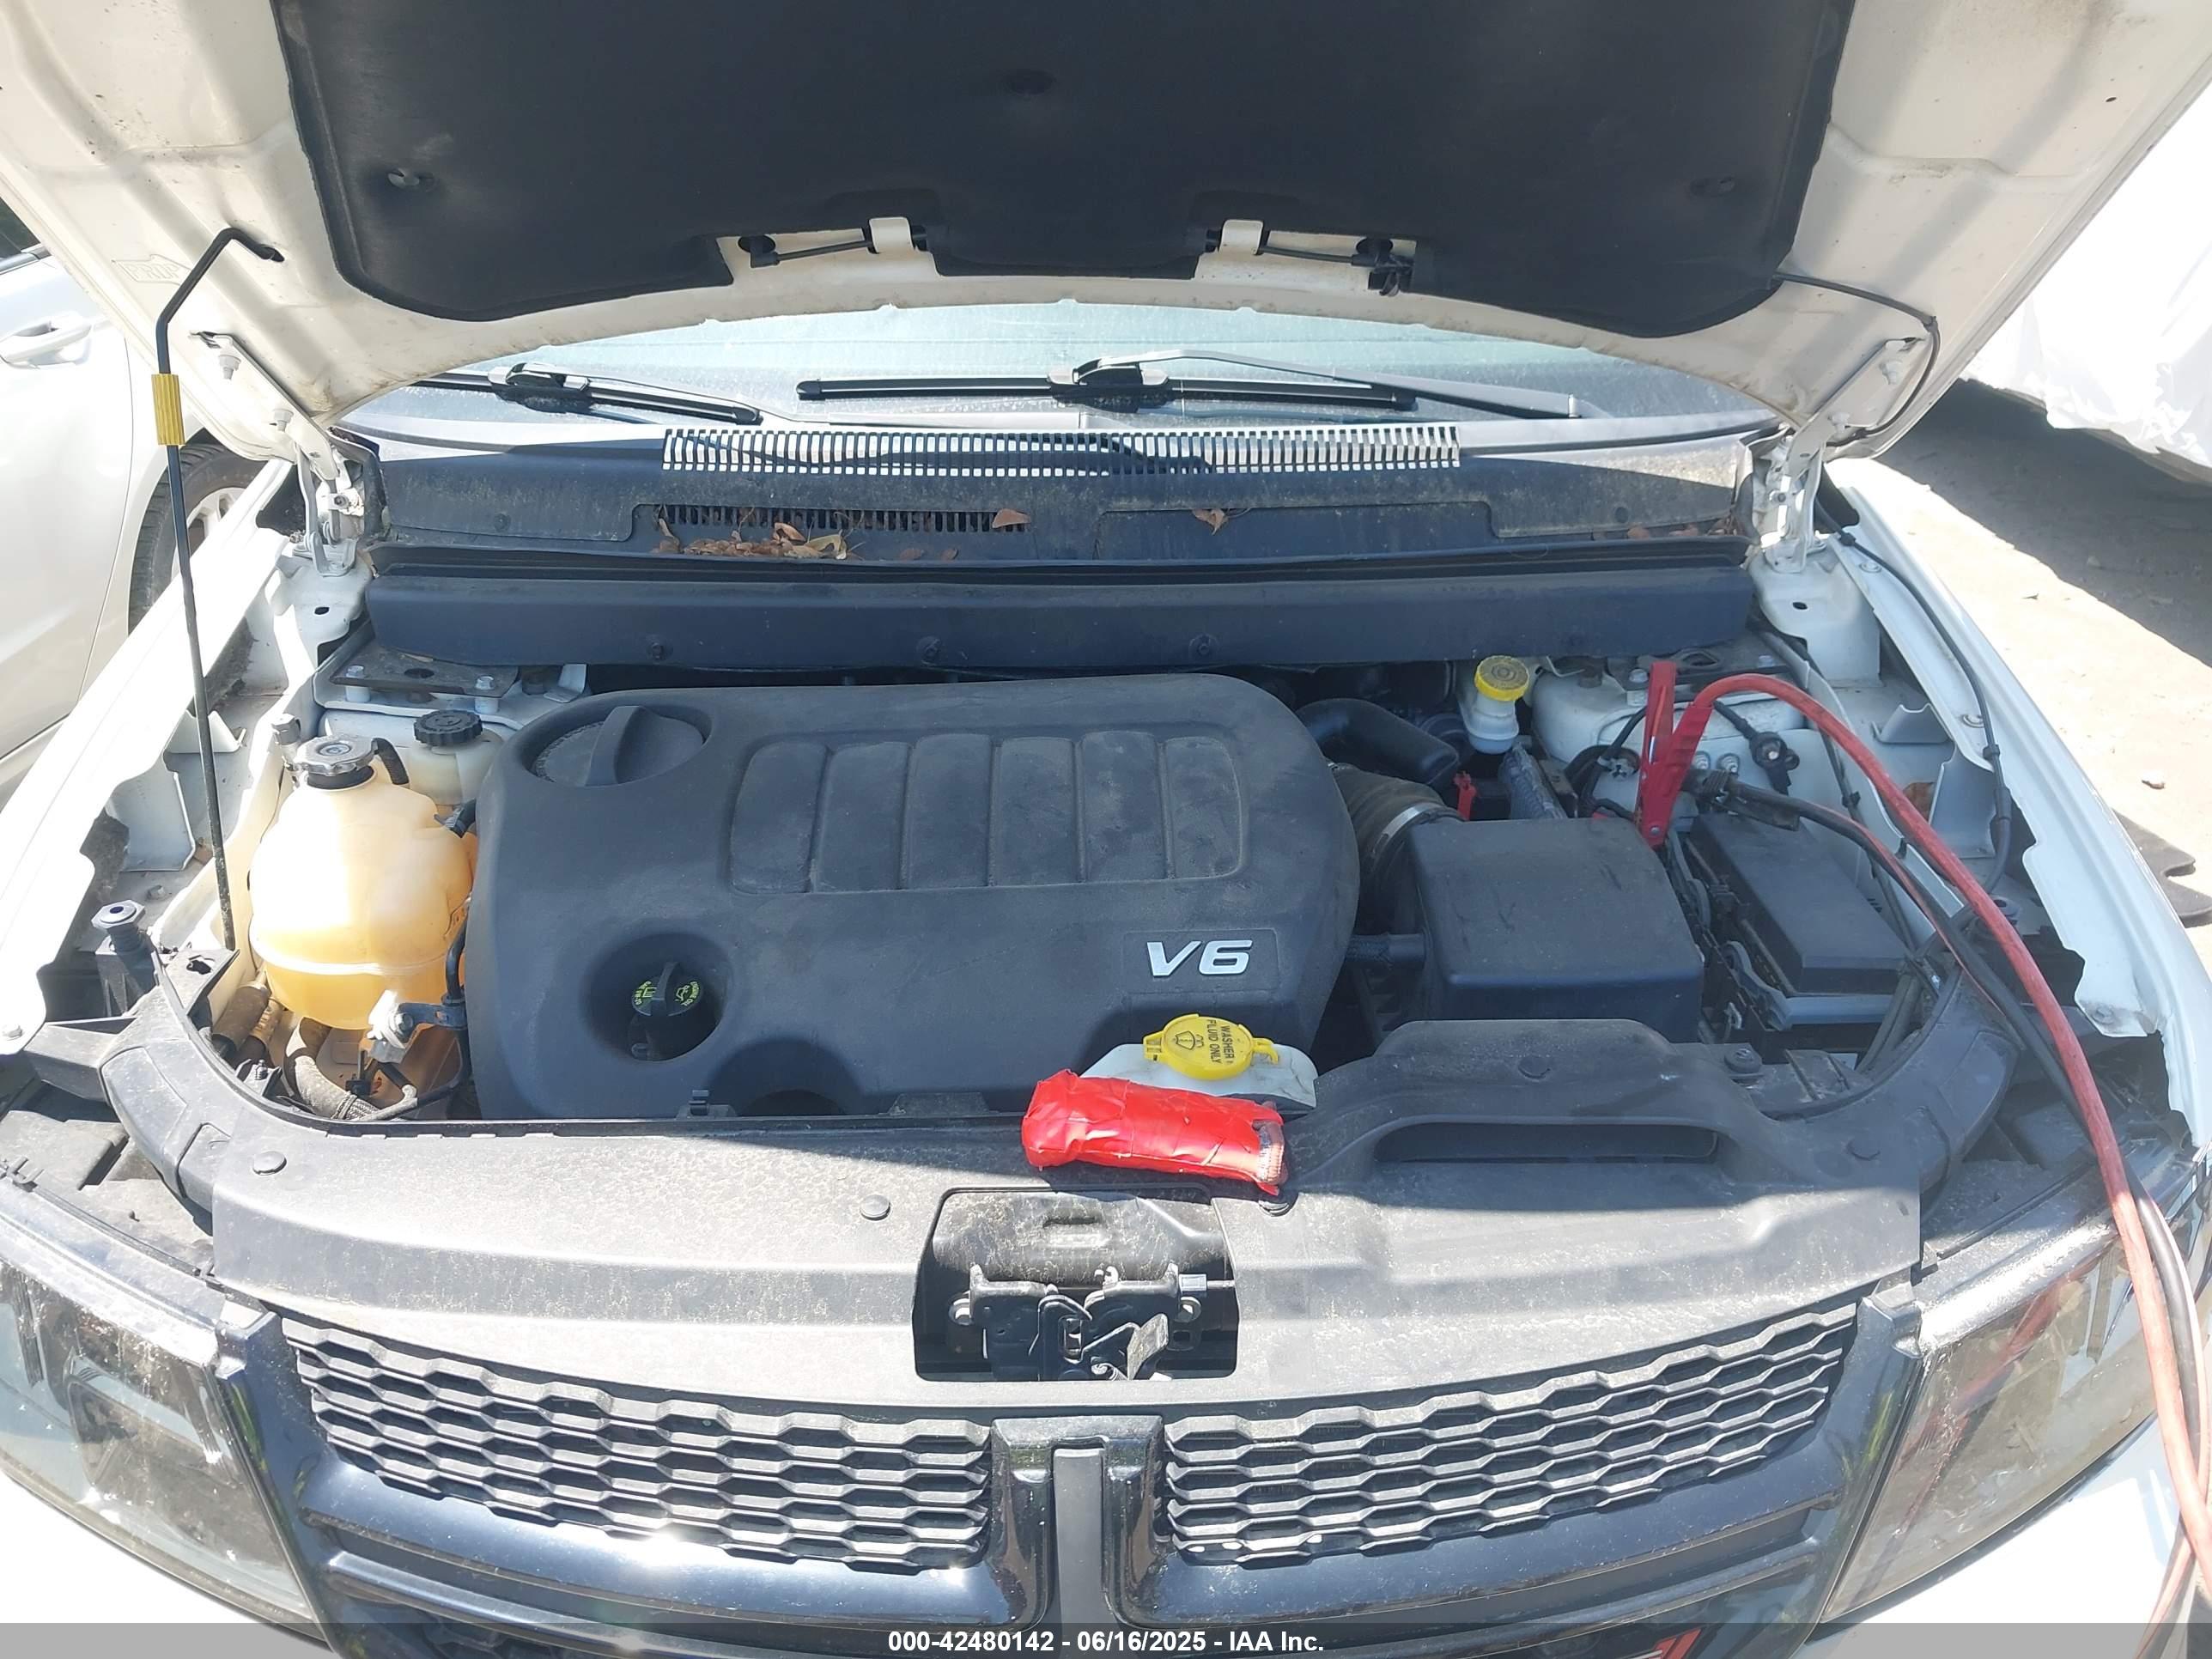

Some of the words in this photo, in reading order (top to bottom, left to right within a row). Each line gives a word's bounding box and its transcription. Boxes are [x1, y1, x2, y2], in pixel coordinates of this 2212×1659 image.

[1146, 939, 1253, 977] V6
[1206, 1019, 1218, 1042] FLUID
[1220, 1025, 1235, 1059] WASHER
[1209, 1043, 1223, 1064] ONLY
